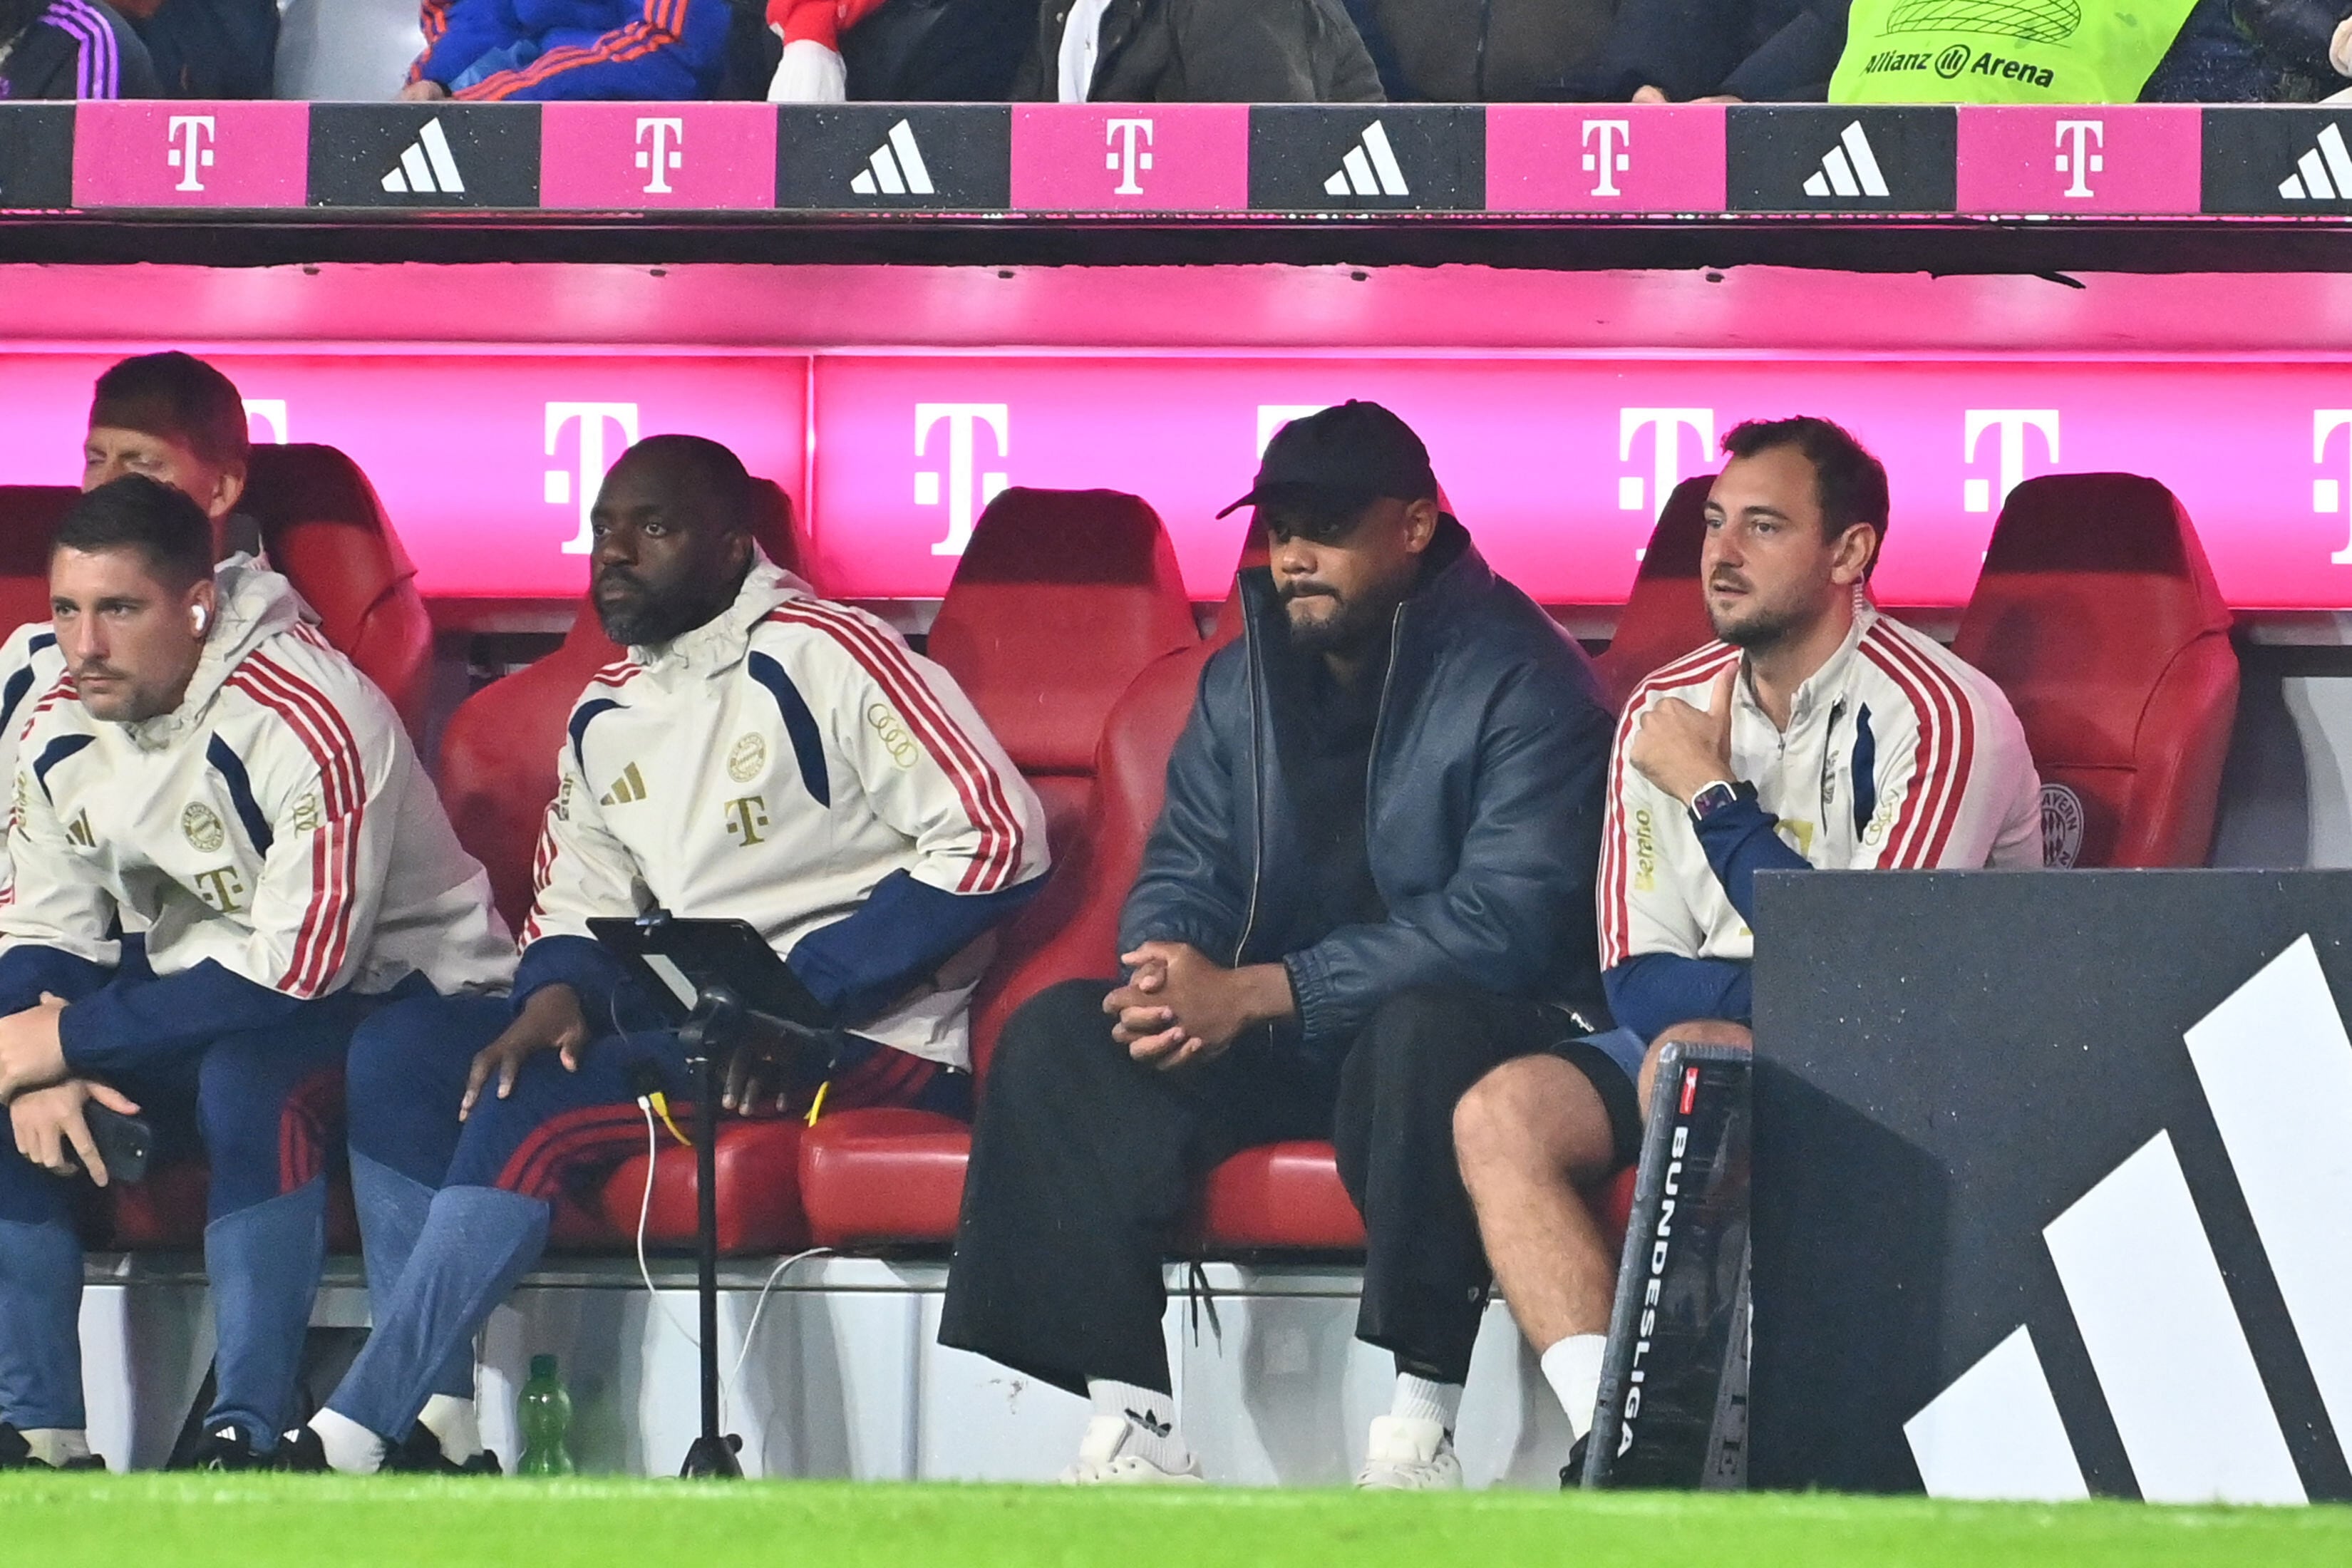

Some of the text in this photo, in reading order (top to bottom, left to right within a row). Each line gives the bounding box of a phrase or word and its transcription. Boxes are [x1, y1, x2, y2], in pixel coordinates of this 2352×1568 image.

[1862, 50, 2055, 88] Allianz Arena
[168, 115, 215, 191] T
[636, 118, 683, 193] T
[1106, 118, 1153, 195] T
[1582, 120, 1629, 196] T
[2056, 120, 2103, 197] T
[724, 795, 769, 847] T
[2041, 792, 2078, 831] AYERN
[194, 865, 244, 913] T
[1616, 1126, 1688, 1458] BUNDESLIGA
